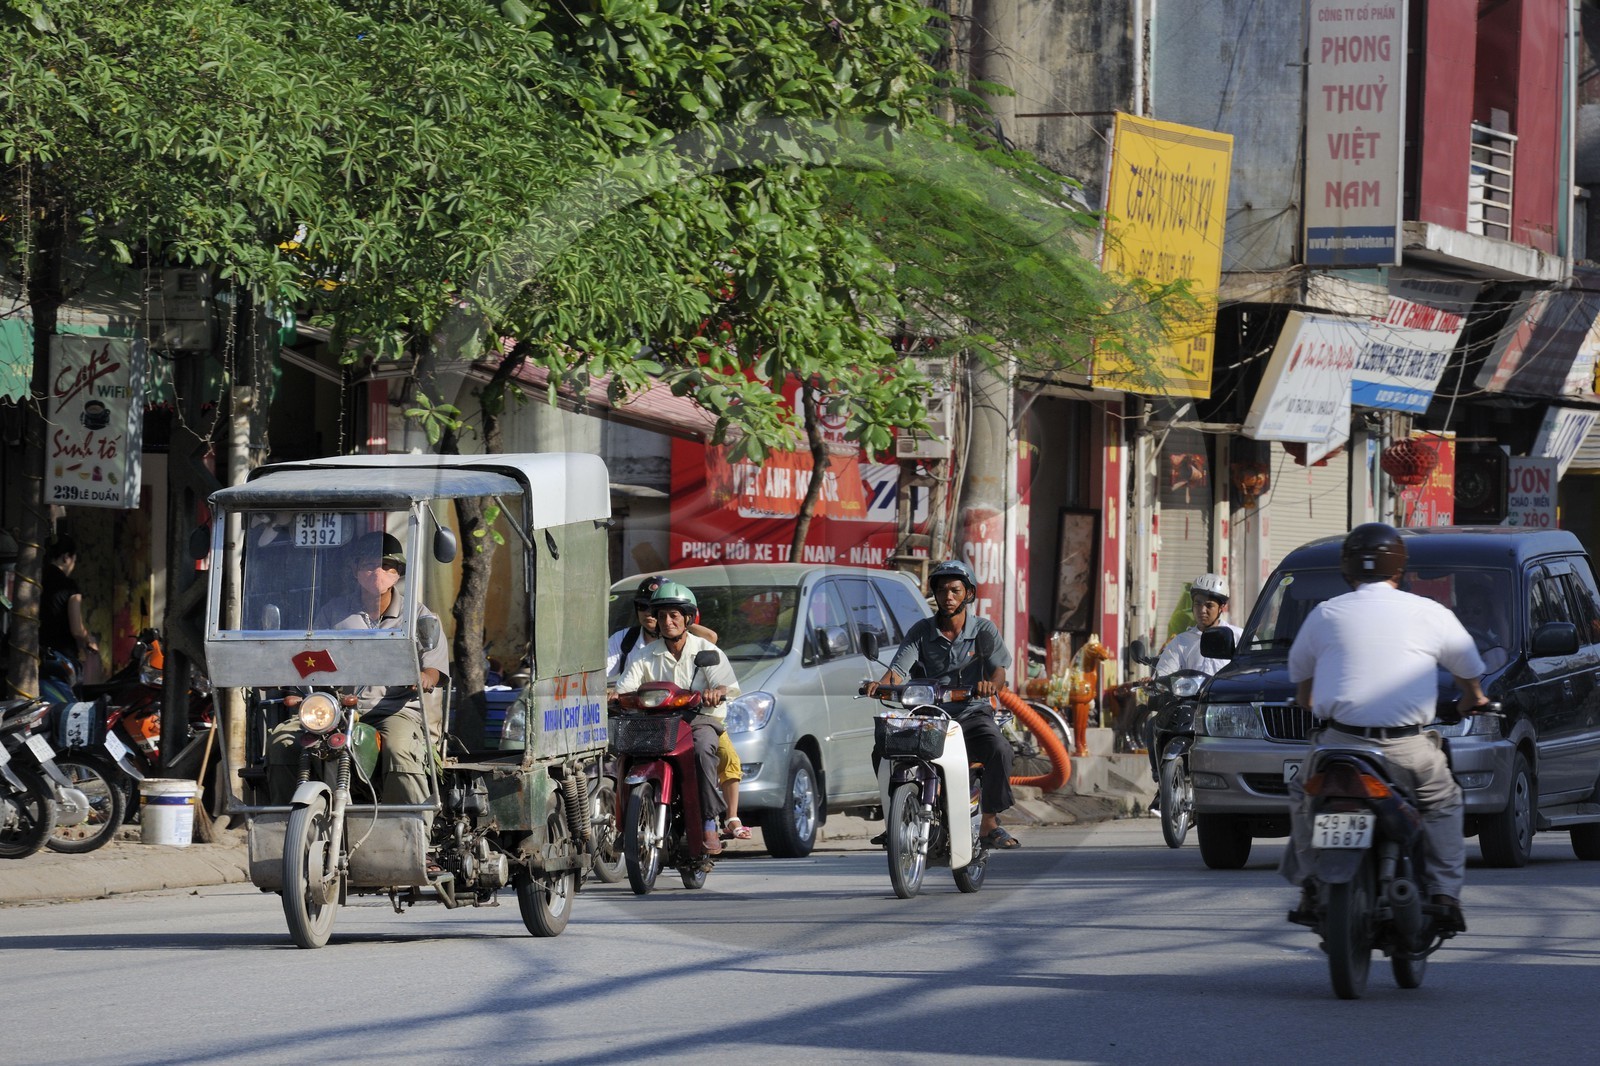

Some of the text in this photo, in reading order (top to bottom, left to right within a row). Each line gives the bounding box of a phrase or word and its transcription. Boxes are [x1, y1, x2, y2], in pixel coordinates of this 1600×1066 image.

[1344, 8, 1355, 21] TY
[1321, 35, 1391, 66] PHONG
[1327, 126, 1381, 166] VIỆT
[1324, 180, 1381, 210] NAM
[54, 344, 118, 401] Café
[53, 429, 122, 459] Sinh tố
[53, 485, 79, 500] 239
[765, 466, 791, 498] ANH
[795, 469, 840, 502] MOR
[301, 529, 336, 545] 3392
[682, 541, 721, 563] PHỤC
[725, 537, 749, 560] HỒI
[754, 543, 773, 560] XE
[804, 545, 836, 562] NAN
[1321, 831, 1364, 846] 1687
